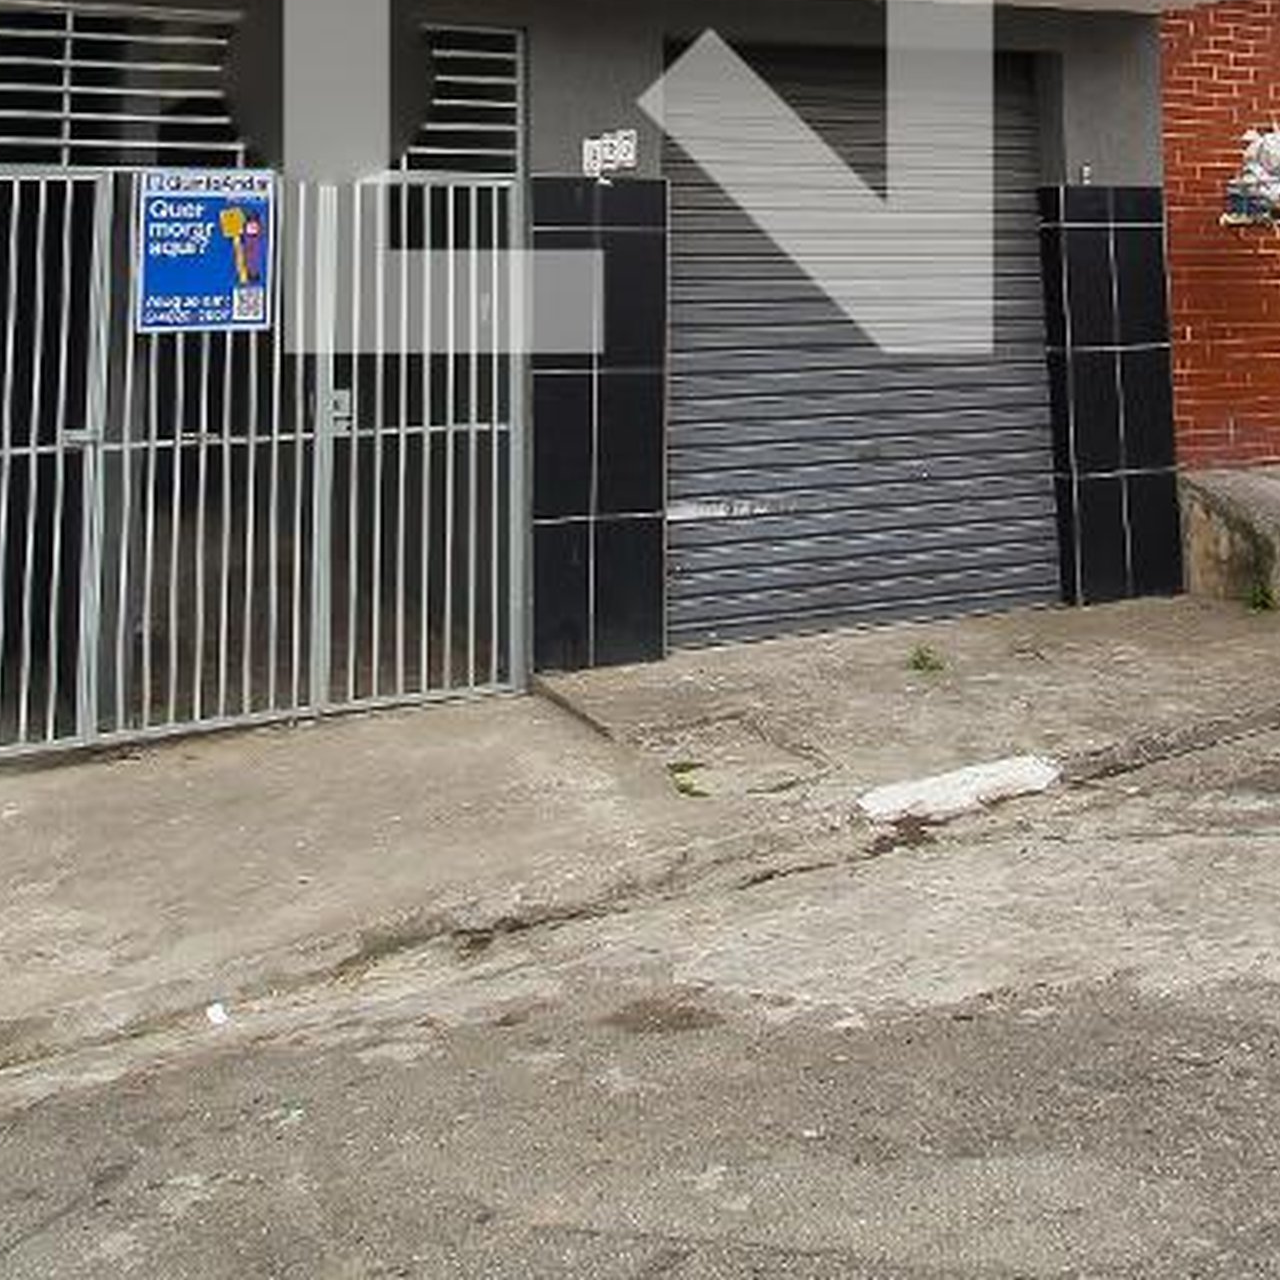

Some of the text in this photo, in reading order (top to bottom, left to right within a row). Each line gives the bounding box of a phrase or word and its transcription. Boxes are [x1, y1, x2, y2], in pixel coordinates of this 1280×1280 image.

[167, 175, 269, 191] QutoAnd
[149, 200, 205, 218] Quer
[149, 222, 214, 238] morar
